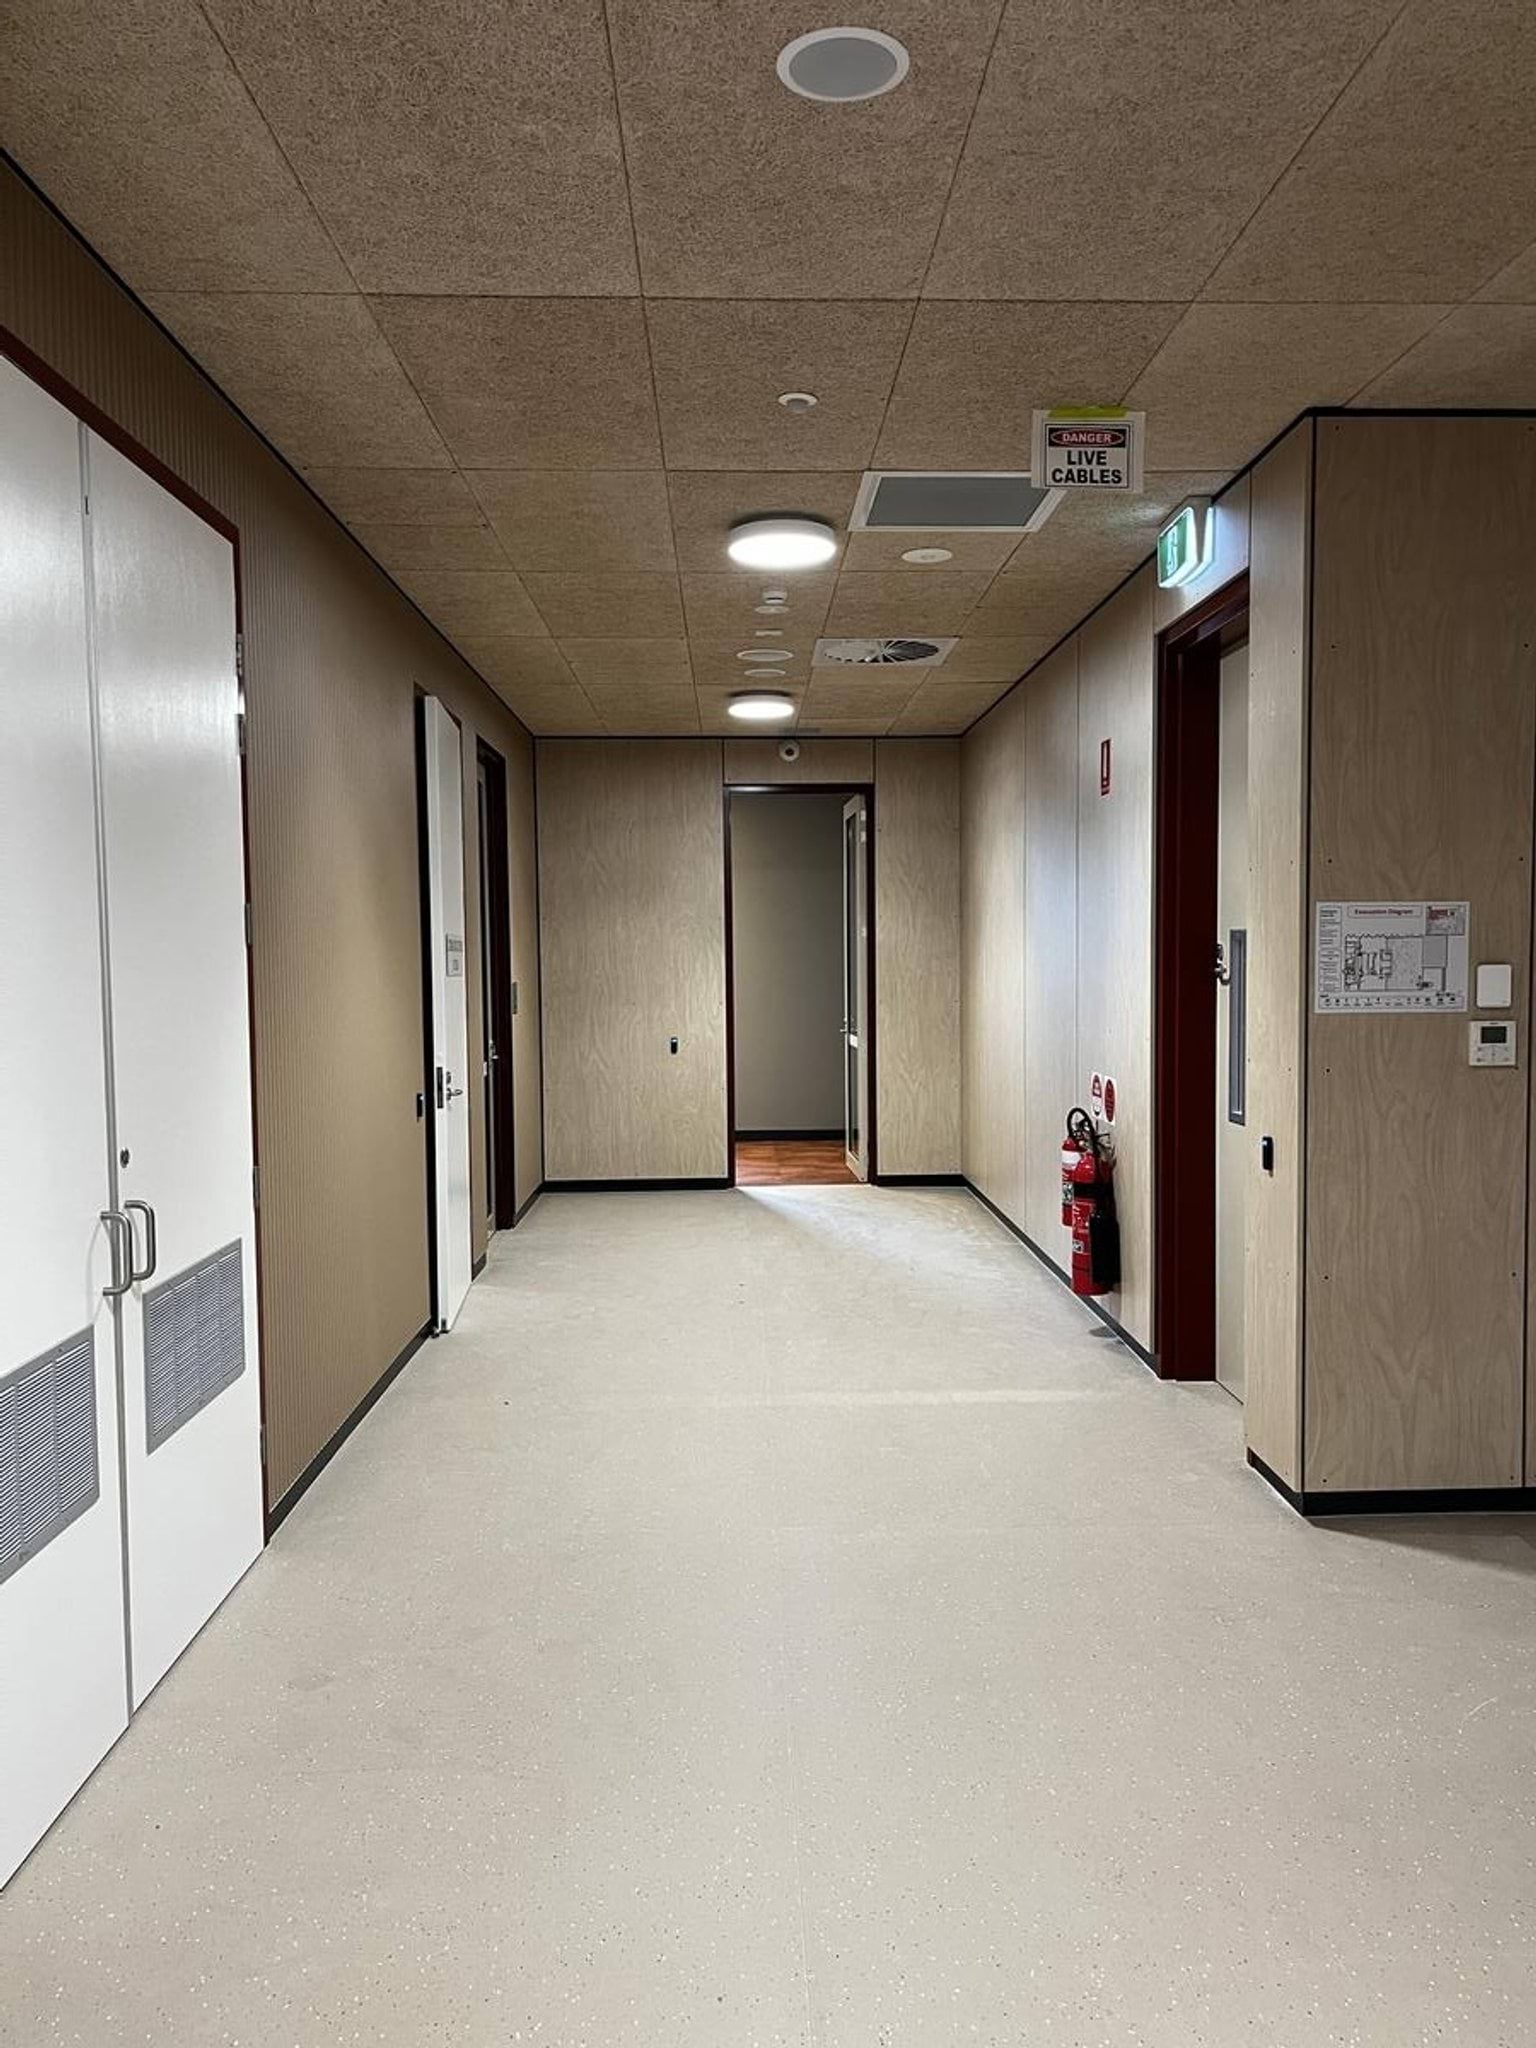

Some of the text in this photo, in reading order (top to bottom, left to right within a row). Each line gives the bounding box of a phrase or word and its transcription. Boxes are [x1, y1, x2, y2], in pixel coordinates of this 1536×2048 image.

[1062, 433, 1112, 443] DANGER
[1067, 451, 1107, 466] LIVE
[1051, 468, 1122, 484] CABLES
